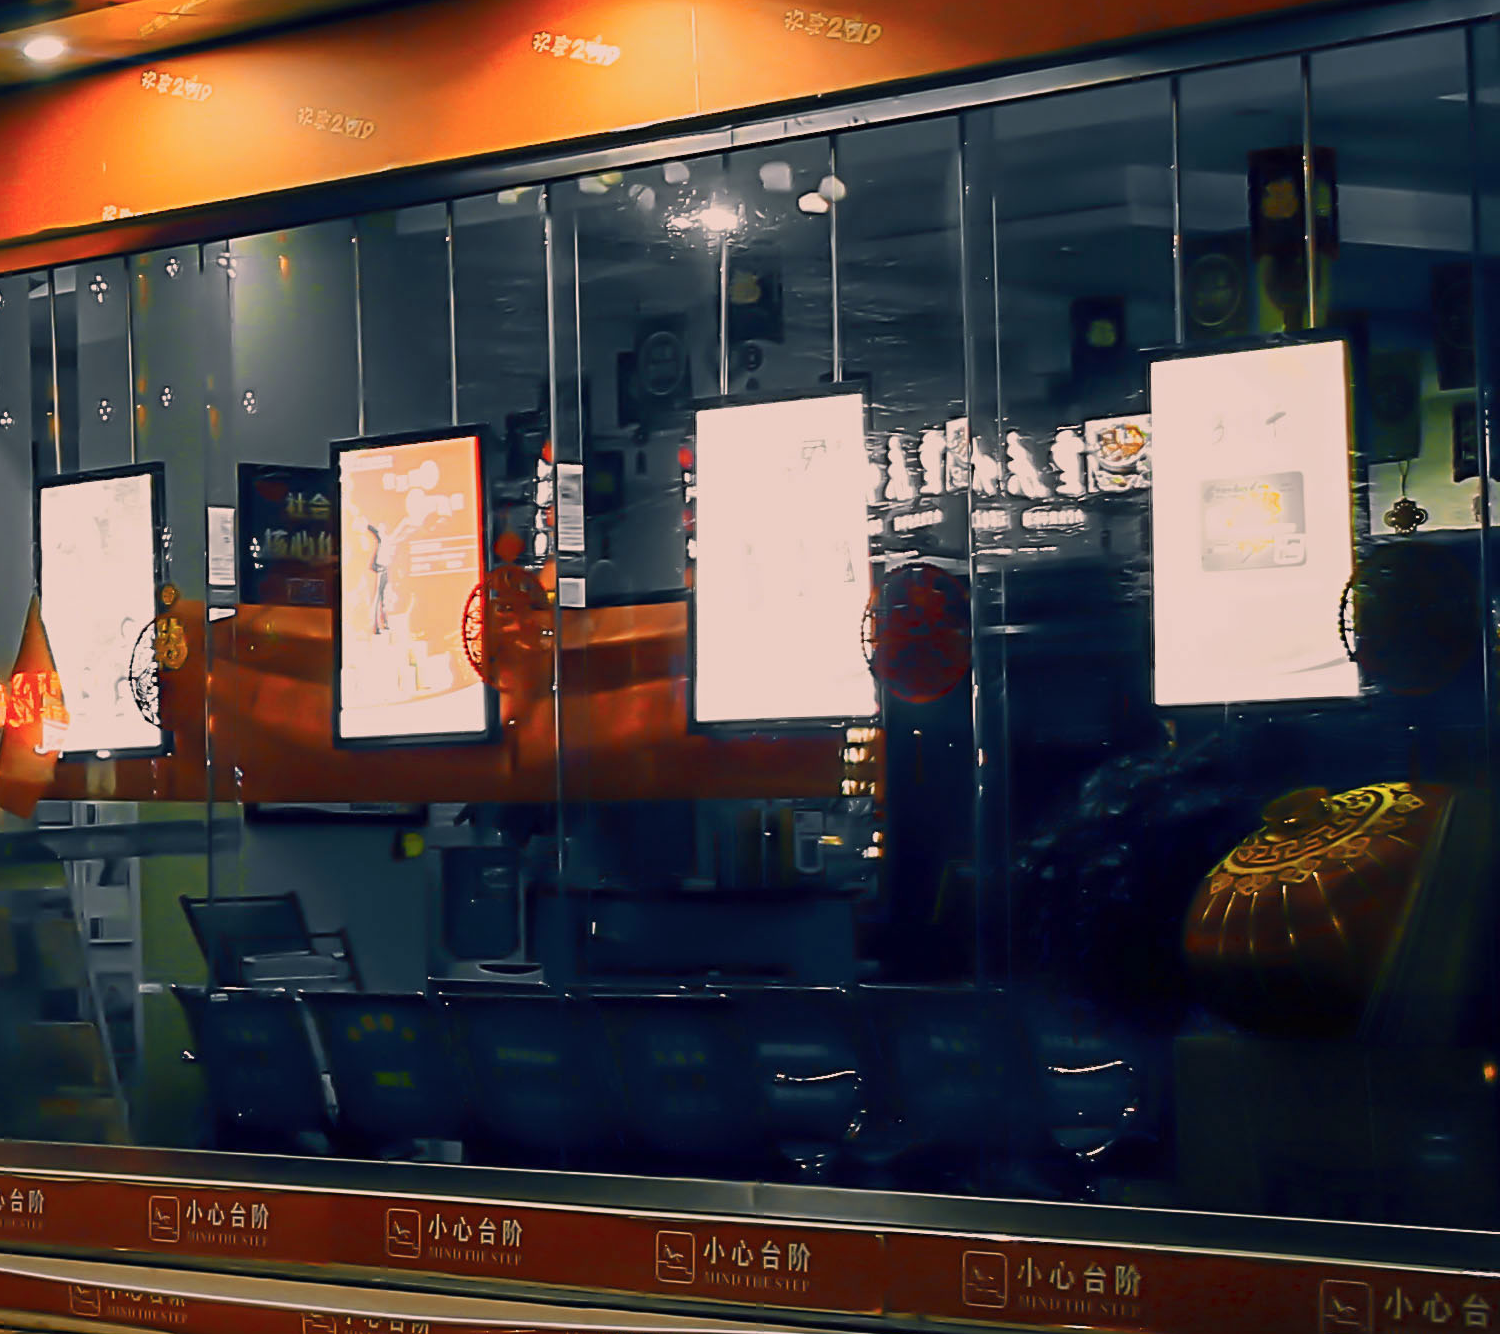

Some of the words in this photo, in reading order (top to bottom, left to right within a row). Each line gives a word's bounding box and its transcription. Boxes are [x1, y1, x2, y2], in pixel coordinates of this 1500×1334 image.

[185, 1199, 269, 1230] 小心台阶
[428, 1213, 523, 1247] 小心台阶
[703, 1236, 811, 1273] 小心台阶
[1017, 1257, 1142, 1298] 小心台阶
